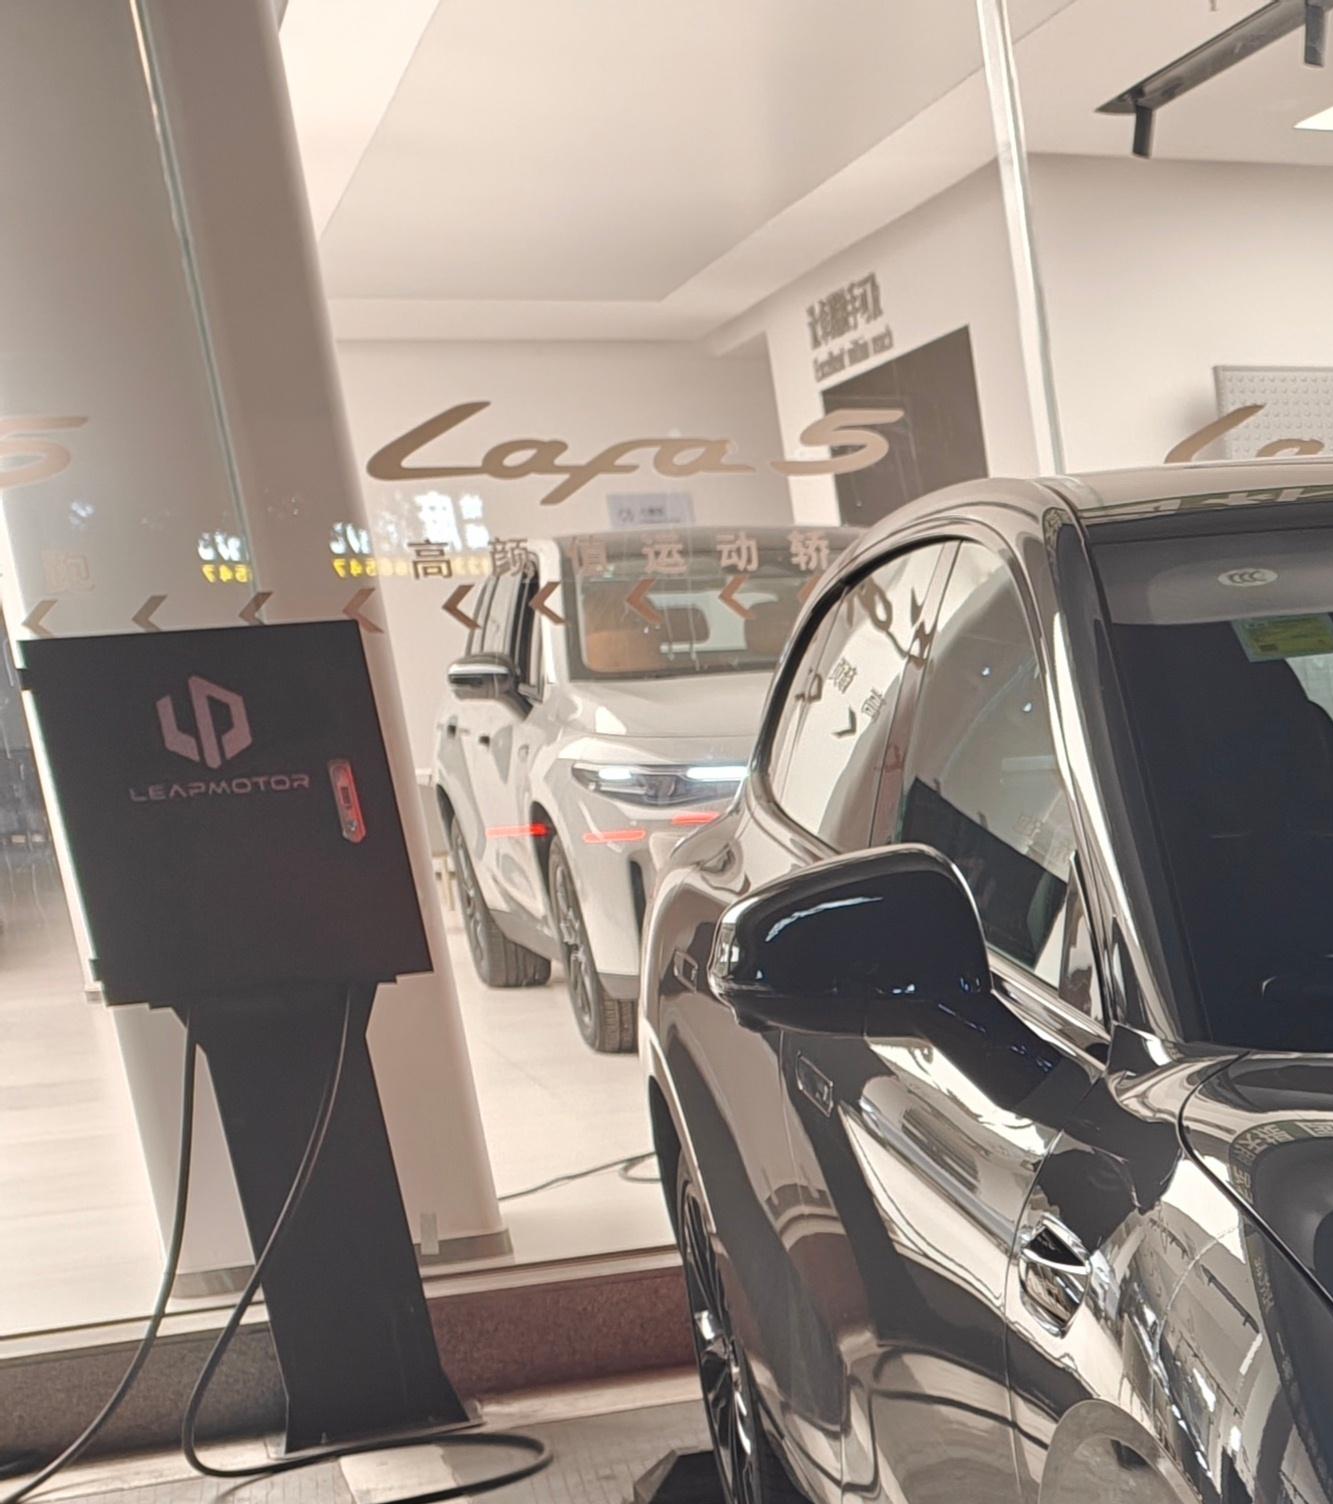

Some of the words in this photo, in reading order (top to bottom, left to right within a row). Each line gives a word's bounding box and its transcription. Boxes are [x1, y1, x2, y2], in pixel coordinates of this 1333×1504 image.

[408, 535, 832, 581] 高颜值运动轿
[128, 773, 311, 802] LEAPMOTOR
